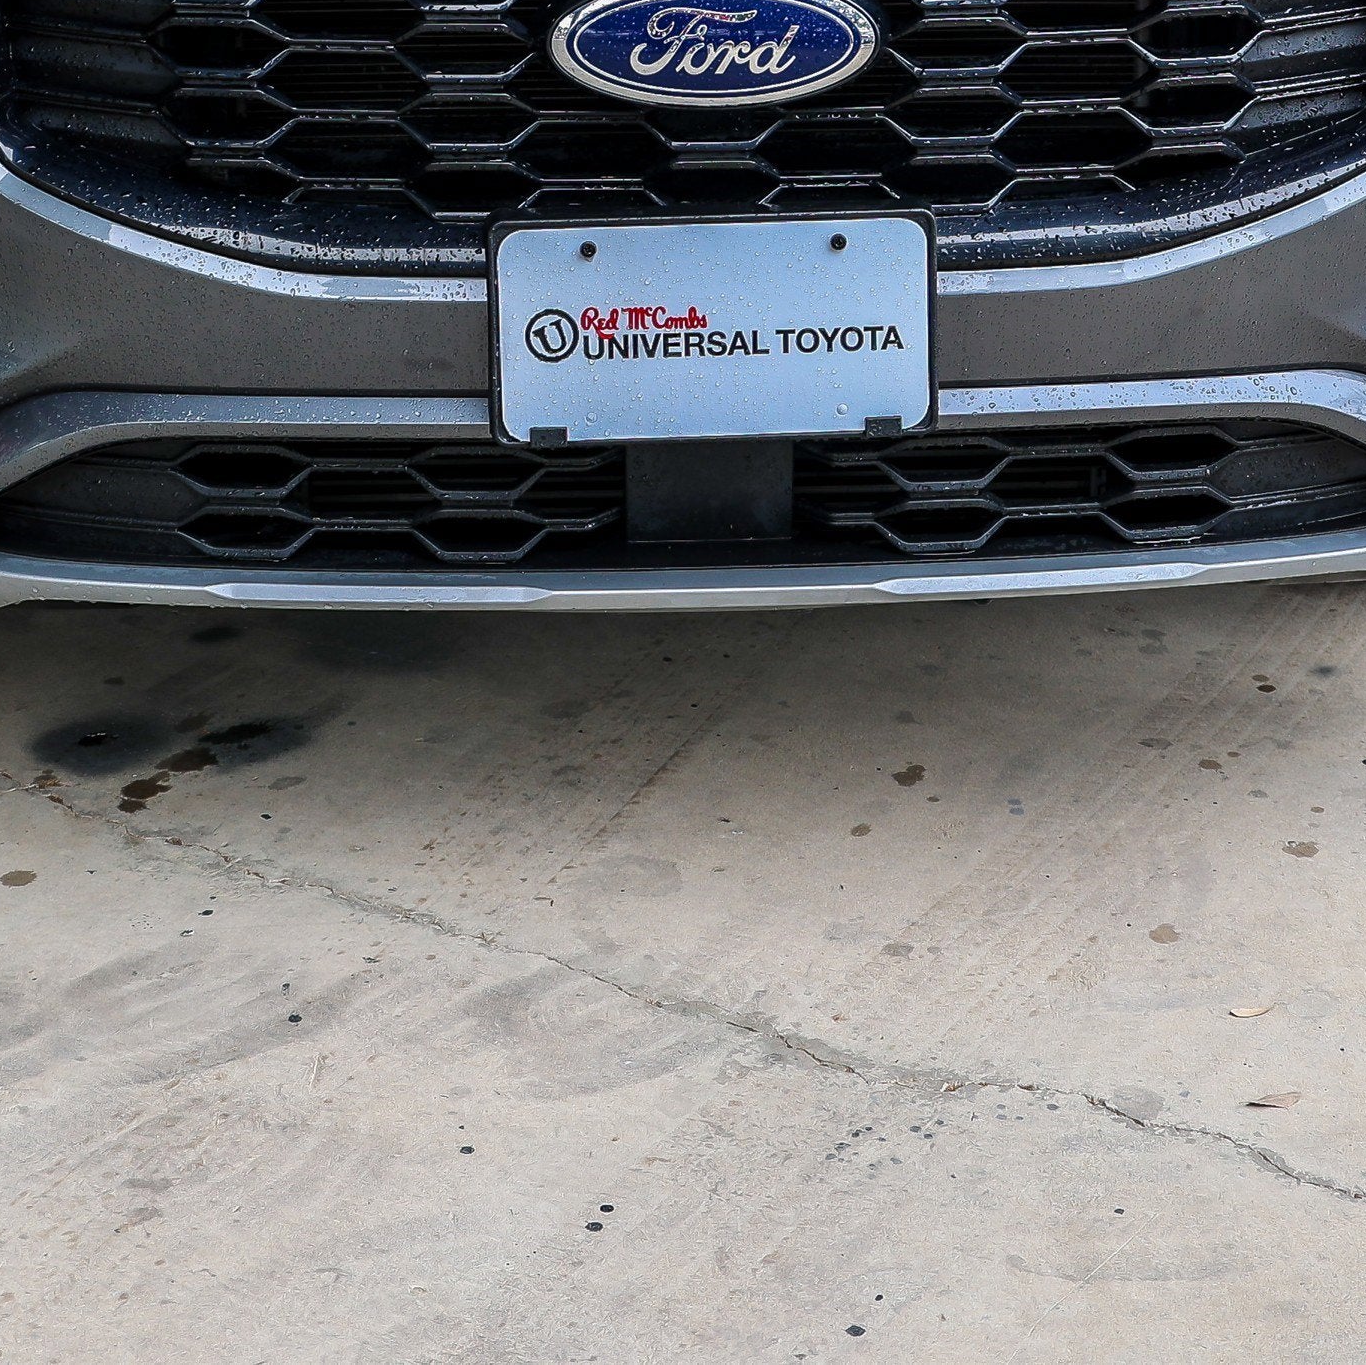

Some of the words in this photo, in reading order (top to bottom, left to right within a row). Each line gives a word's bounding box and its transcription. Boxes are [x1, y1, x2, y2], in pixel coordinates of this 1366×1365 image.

[630, 7, 800, 75] Ford
[580, 306, 620, 339] Red
[621, 306, 707, 330] McCombs
[583, 329, 770, 360] UNIVERSAL
[775, 325, 905, 354] TOYOTA
